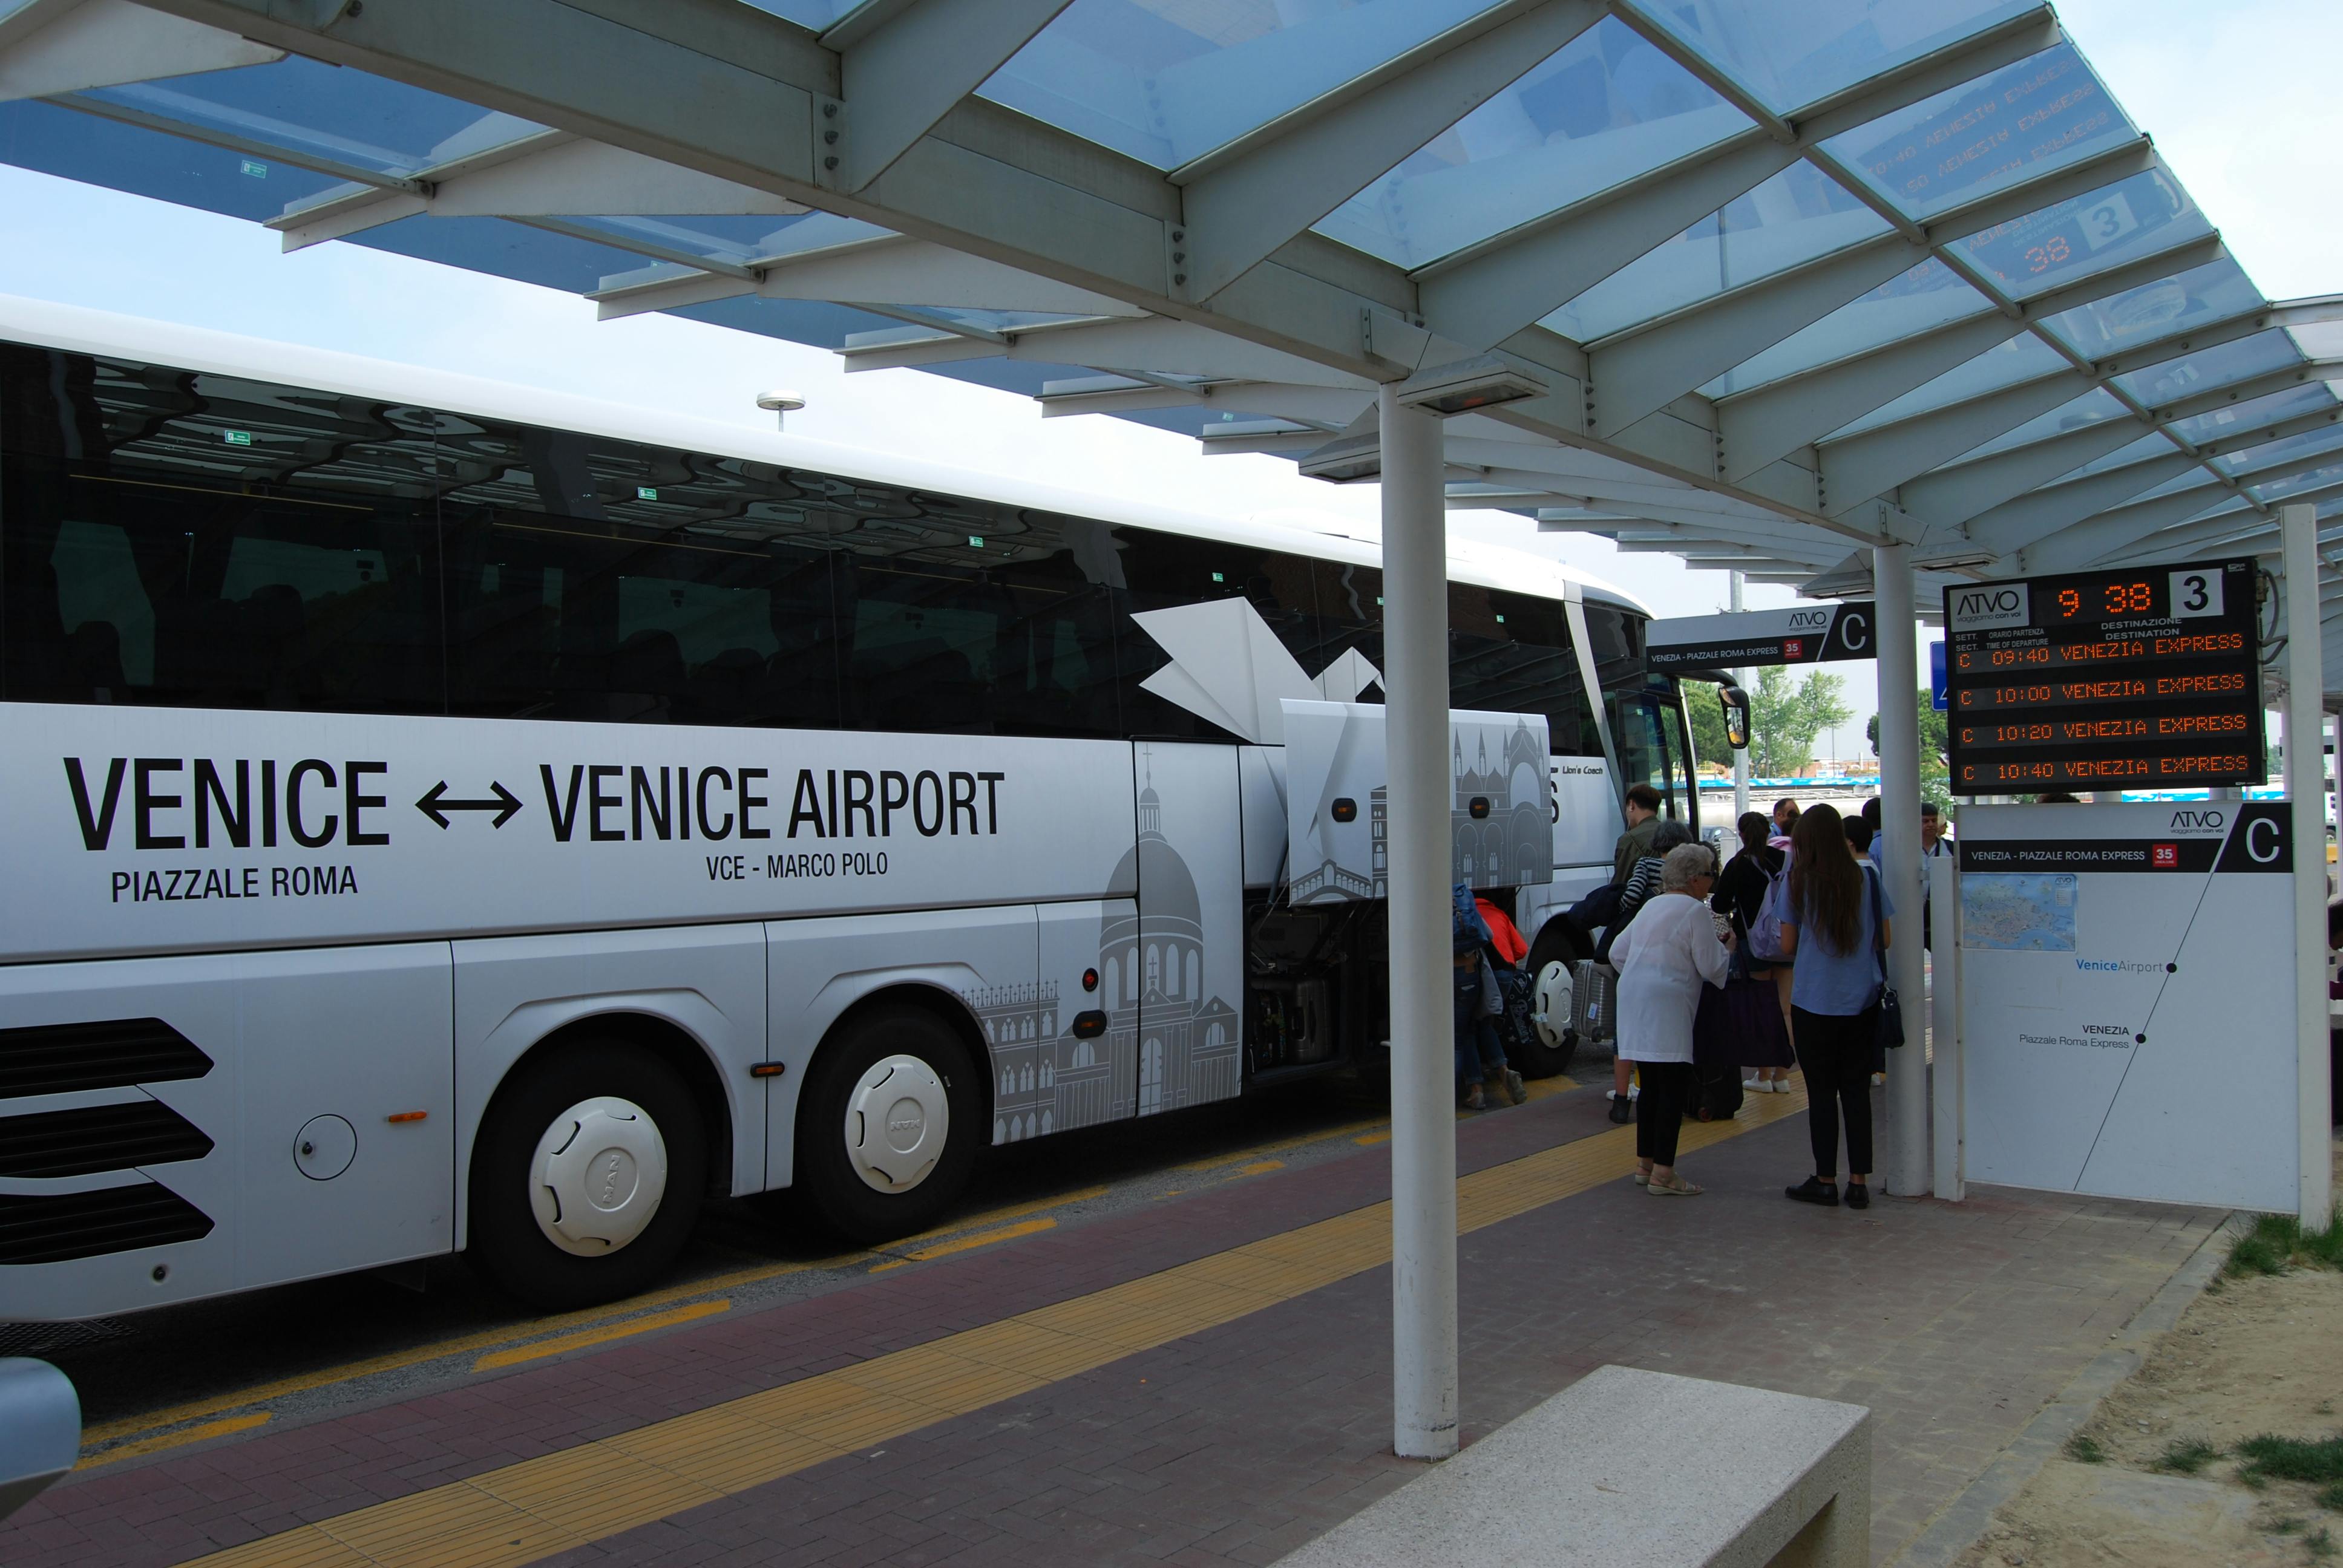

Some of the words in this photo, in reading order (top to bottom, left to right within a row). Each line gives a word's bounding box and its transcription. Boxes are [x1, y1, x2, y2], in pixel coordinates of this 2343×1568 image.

[1958, 590, 2019, 616] ATVO
[2059, 589, 2080, 617] 9
[2105, 583, 2151, 613] 38
[2183, 575, 2209, 611] 3
[1789, 611, 1827, 627] ATVO
[1956, 613, 1994, 624] viaggiamo
[2101, 617, 2182, 630] DESTINAZIONE
[1841, 613, 1867, 650] C
[1955, 633, 1979, 642] SETT.
[1988, 630, 2012, 639] ORARIO
[2013, 627, 2045, 636] PARTENZA
[2105, 629, 2180, 641] DESTINATION
[1651, 653, 1681, 662] VENEZIA
[1686, 650, 1719, 661] PIAZZALE
[1720, 648, 1746, 658] ROMA
[1747, 646, 1778, 656] EXPRESS
[1786, 643, 1799, 653] 35
[1956, 643, 1979, 652] SECT.
[2012, 638, 2049, 647] DEPARTURE
[1959, 653, 1971, 668] C
[1992, 647, 2049, 666] 09:40
[2060, 640, 2144, 661] VENEZIA
[2155, 633, 2243, 655] EXPRESS
[1961, 691, 1972, 705] C
[1996, 686, 2051, 704] 10:00
[2062, 681, 2145, 699] VENEZIA
[2157, 674, 2245, 694] EXPRESS
[1962, 728, 1974, 743] C
[1997, 724, 2053, 742] 10:20
[2063, 719, 2148, 738] VENEZIA
[2159, 714, 2247, 734] EXPRESS
[1583, 765, 1604, 775] Coach
[1963, 766, 1975, 780] C
[1999, 762, 2054, 779] 10:40
[2064, 759, 2149, 777] VENEZIA
[2160, 754, 2249, 774] EXPRESS
[63, 756, 390, 851] VENICE
[539, 763, 772, 843] VENICE
[787, 768, 1006, 839] AIRPORT
[2171, 811, 2224, 828] ATVO
[2246, 817, 2280, 863] C
[1971, 851, 2011, 861] VENEZIA
[2019, 851, 2062, 861] PIAZZALE
[2065, 851, 2099, 861] ROMA
[2102, 851, 2145, 861] EXPRESS
[2156, 848, 2174, 860] 35
[706, 855, 745, 881] VCE
[767, 853, 836, 879] MARCO
[842, 851, 888, 877] POLO
[111, 867, 259, 903] PIAZZALE
[271, 865, 358, 897] ROMA
[2082, 1025, 2129, 1036] VENEZIA
[2019, 1034, 2057, 1045] Piazzale
[2059, 1036, 2088, 1047] Roma
[2090, 1038, 2129, 1050] Express
[601, 1154, 620, 1203] MAN
